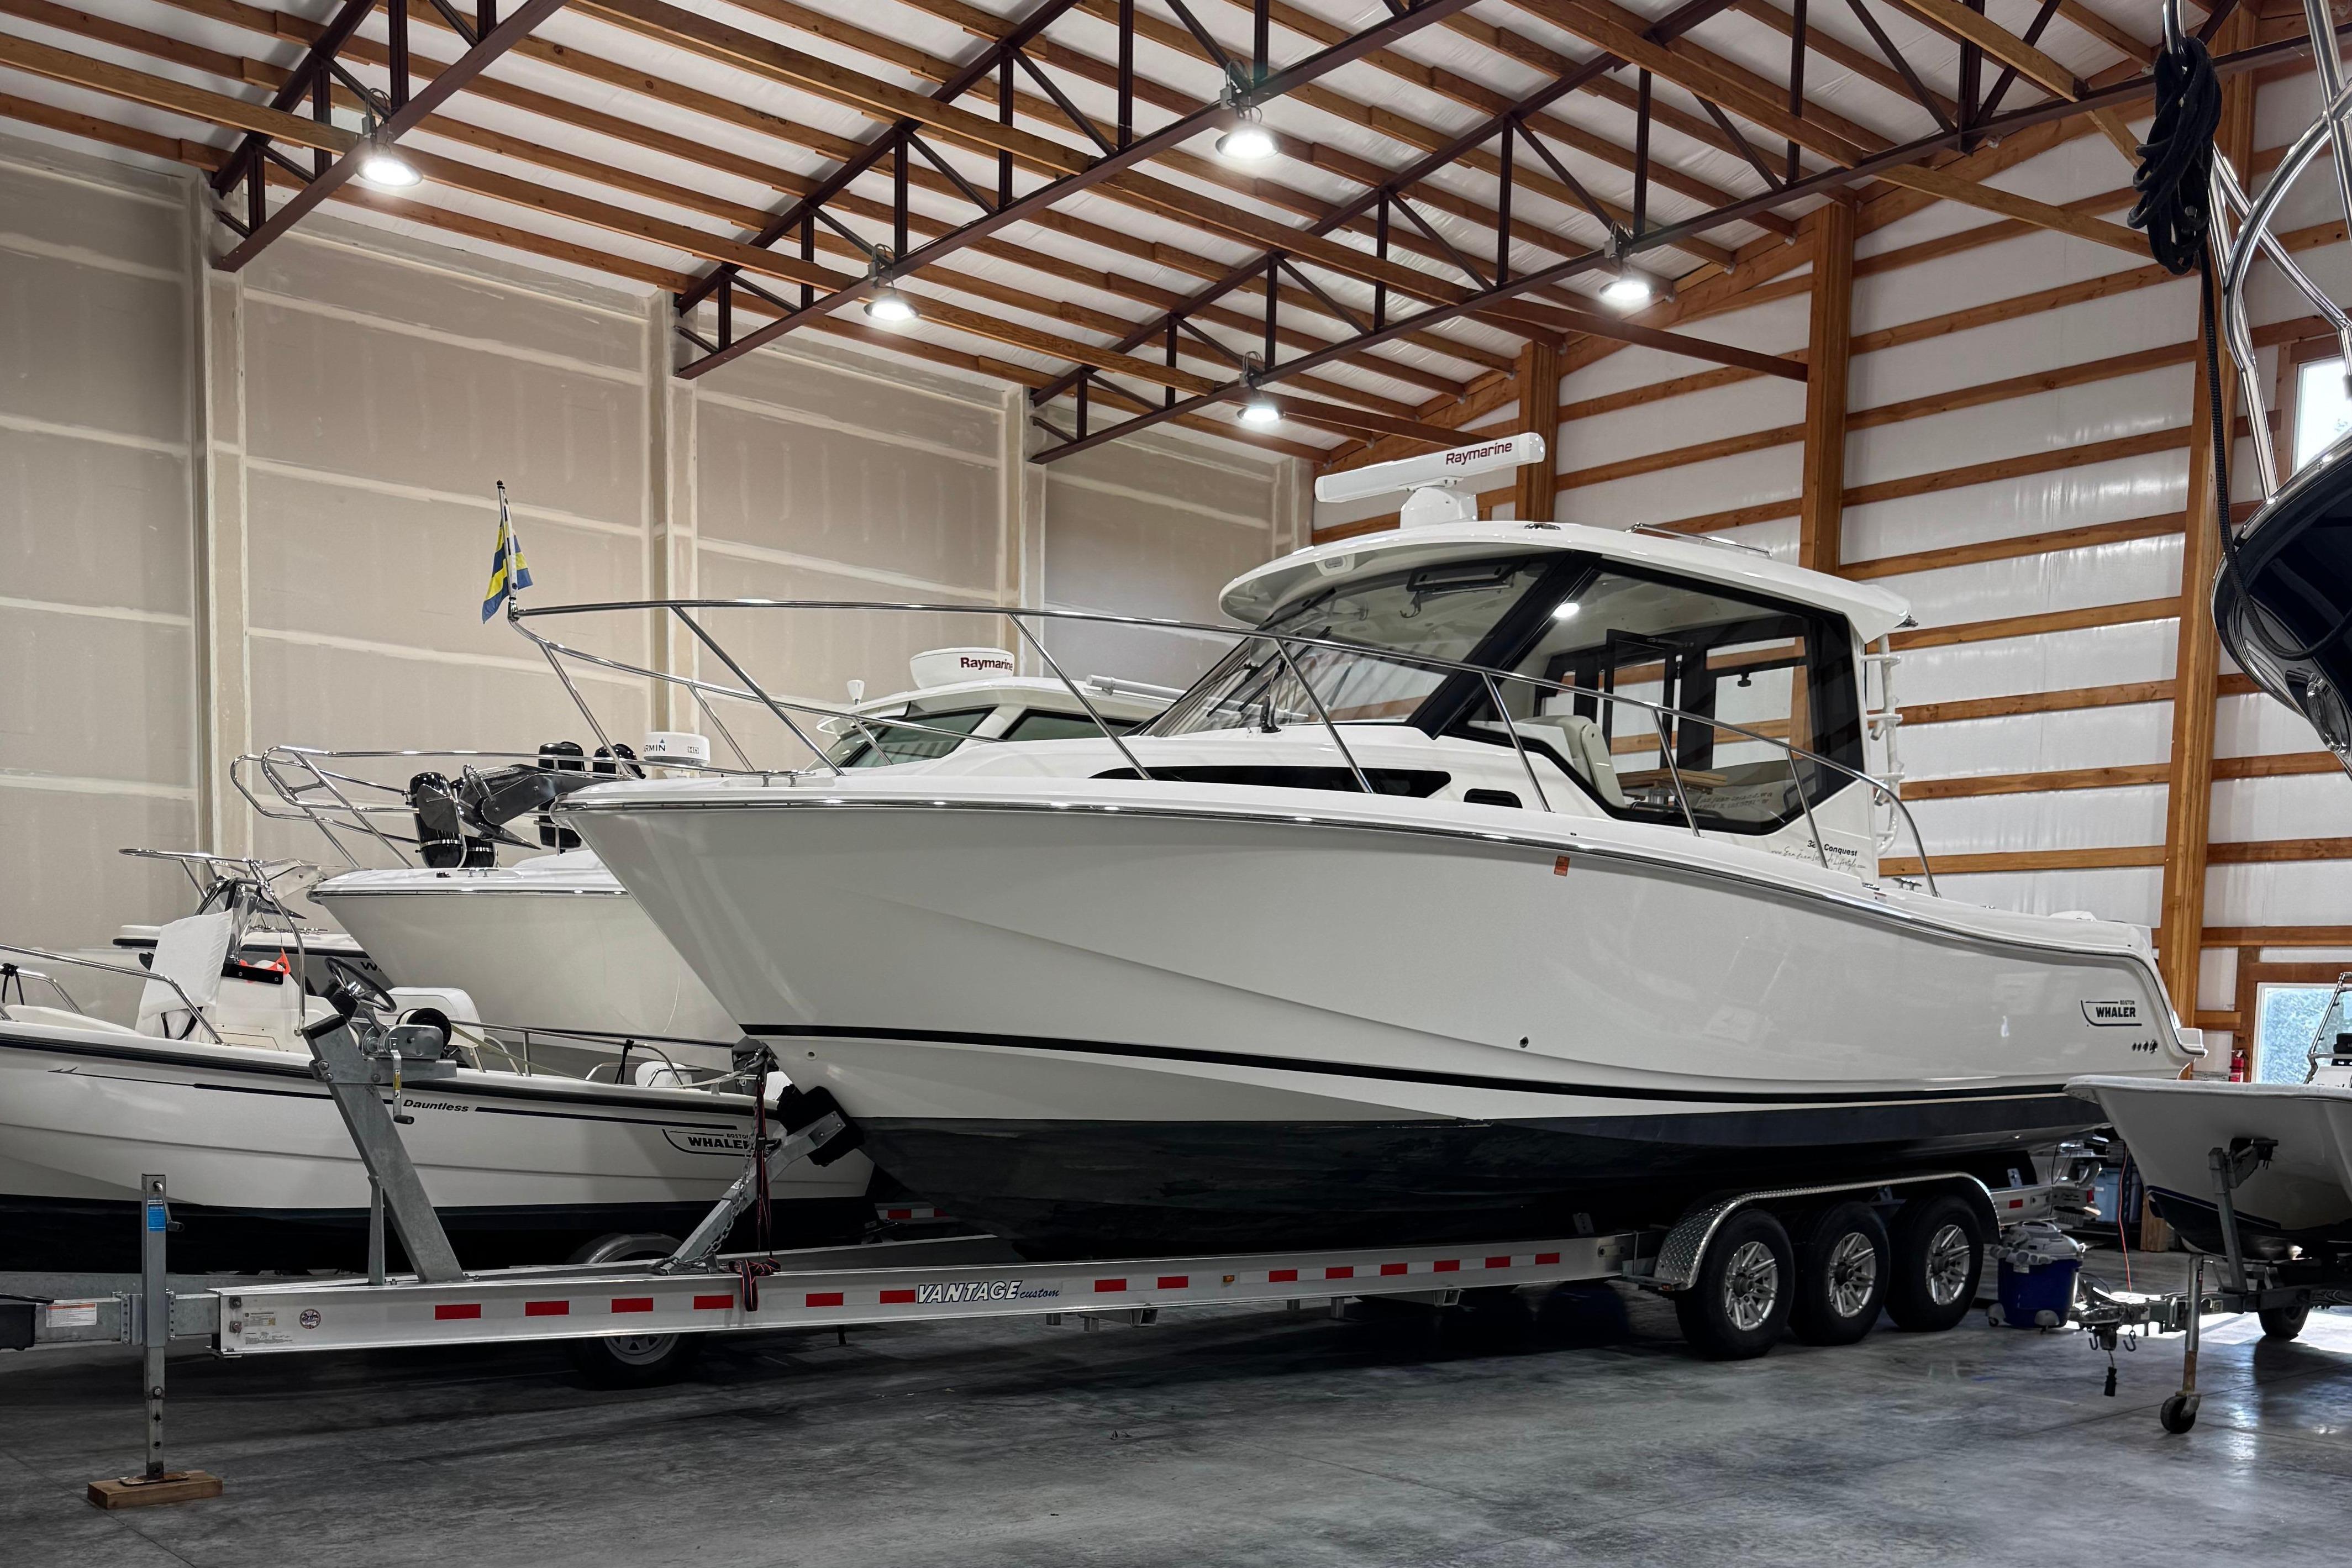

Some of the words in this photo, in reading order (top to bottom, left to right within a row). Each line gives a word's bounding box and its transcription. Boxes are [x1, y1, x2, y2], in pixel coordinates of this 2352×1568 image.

[1446, 442, 1512, 465] Raymarine
[960, 657, 1013, 671] Raymarine
[1824, 843, 1858, 856] Conquest
[2096, 1007, 2136, 1018] WHALER
[403, 1099, 469, 1112] Dauntless
[917, 1280, 1023, 1304] VANTAGE
[1020, 1288, 1059, 1299] custom
